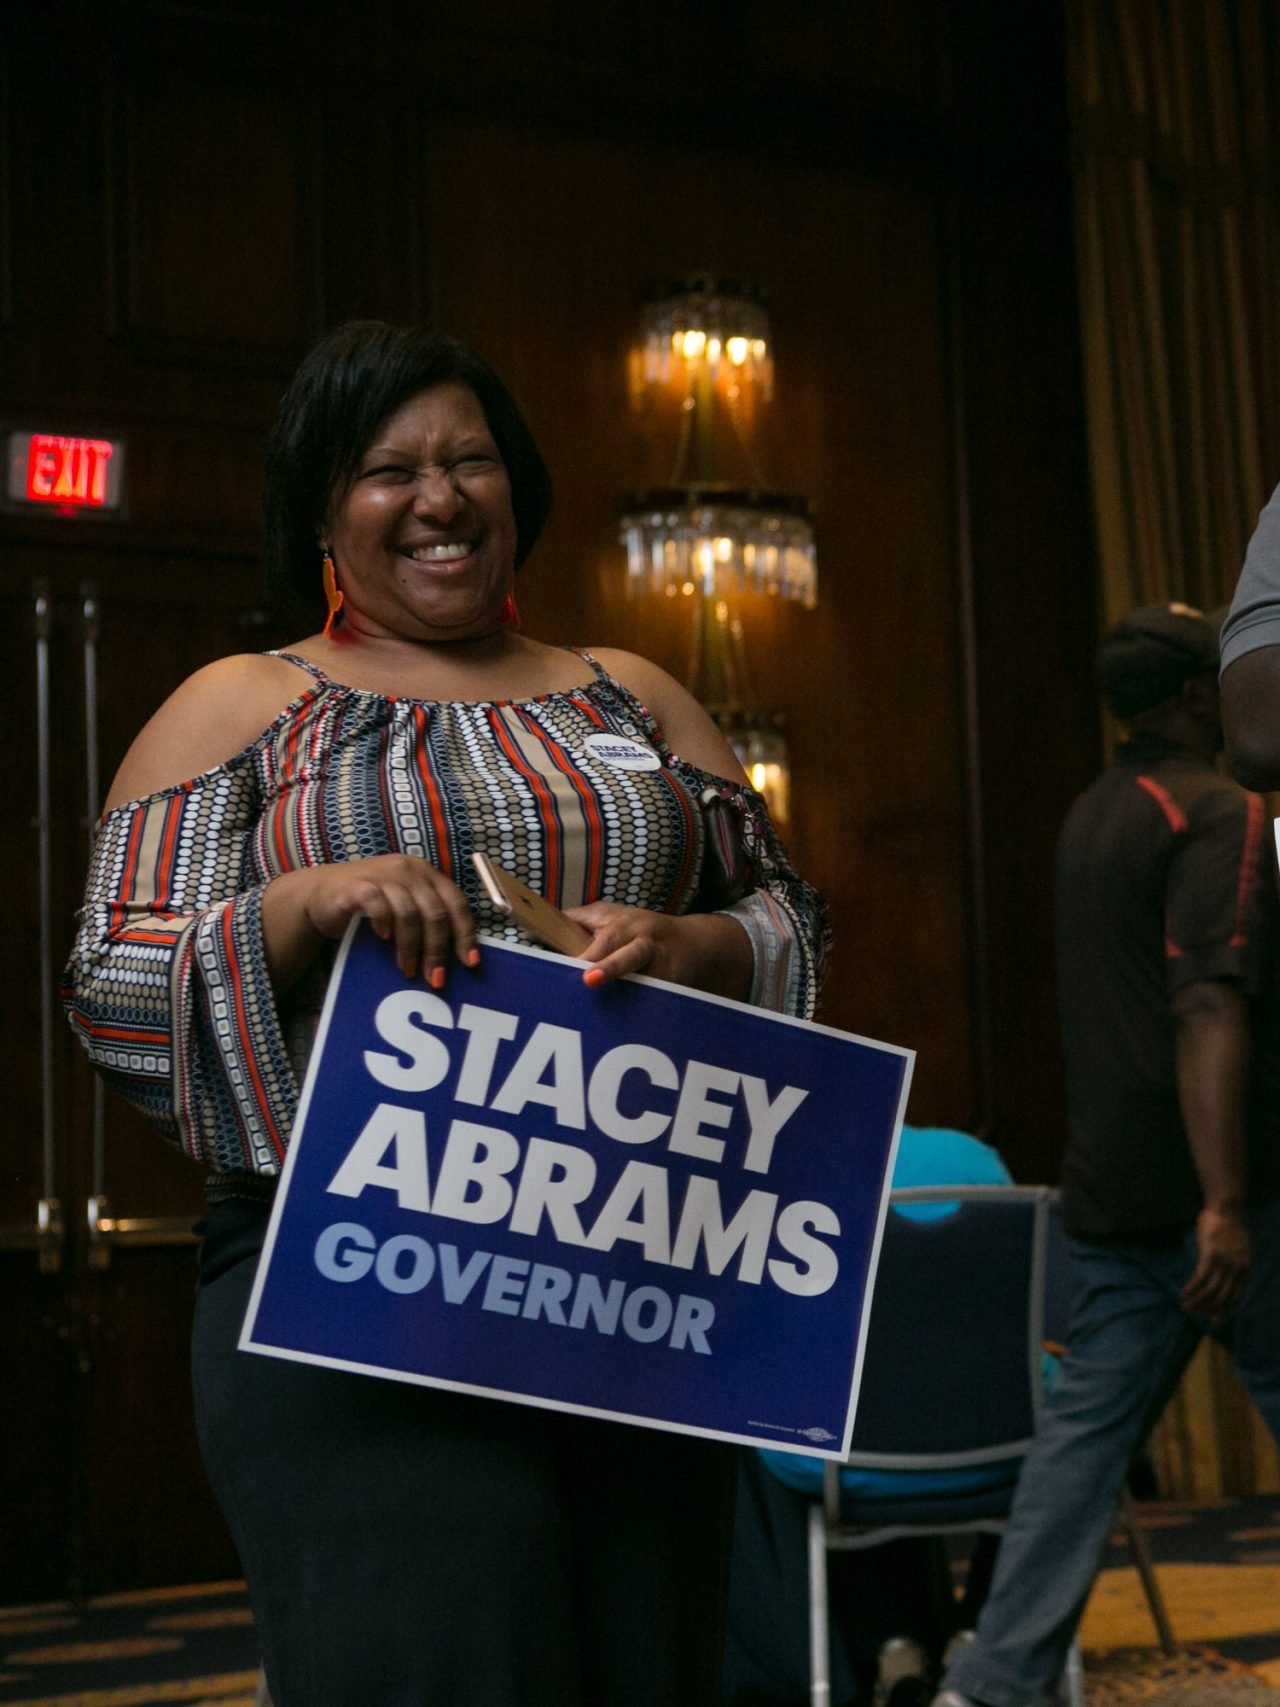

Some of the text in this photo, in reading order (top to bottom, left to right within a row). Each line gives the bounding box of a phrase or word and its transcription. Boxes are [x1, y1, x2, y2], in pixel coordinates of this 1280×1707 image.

[28, 434, 113, 506] EXIT
[590, 744, 637, 753] STACEY
[598, 751, 654, 759] ABRAMS
[363, 989, 810, 1175] STACEY
[325, 1102, 842, 1297] ABRAMS
[313, 1221, 717, 1356] GOVERNOR
